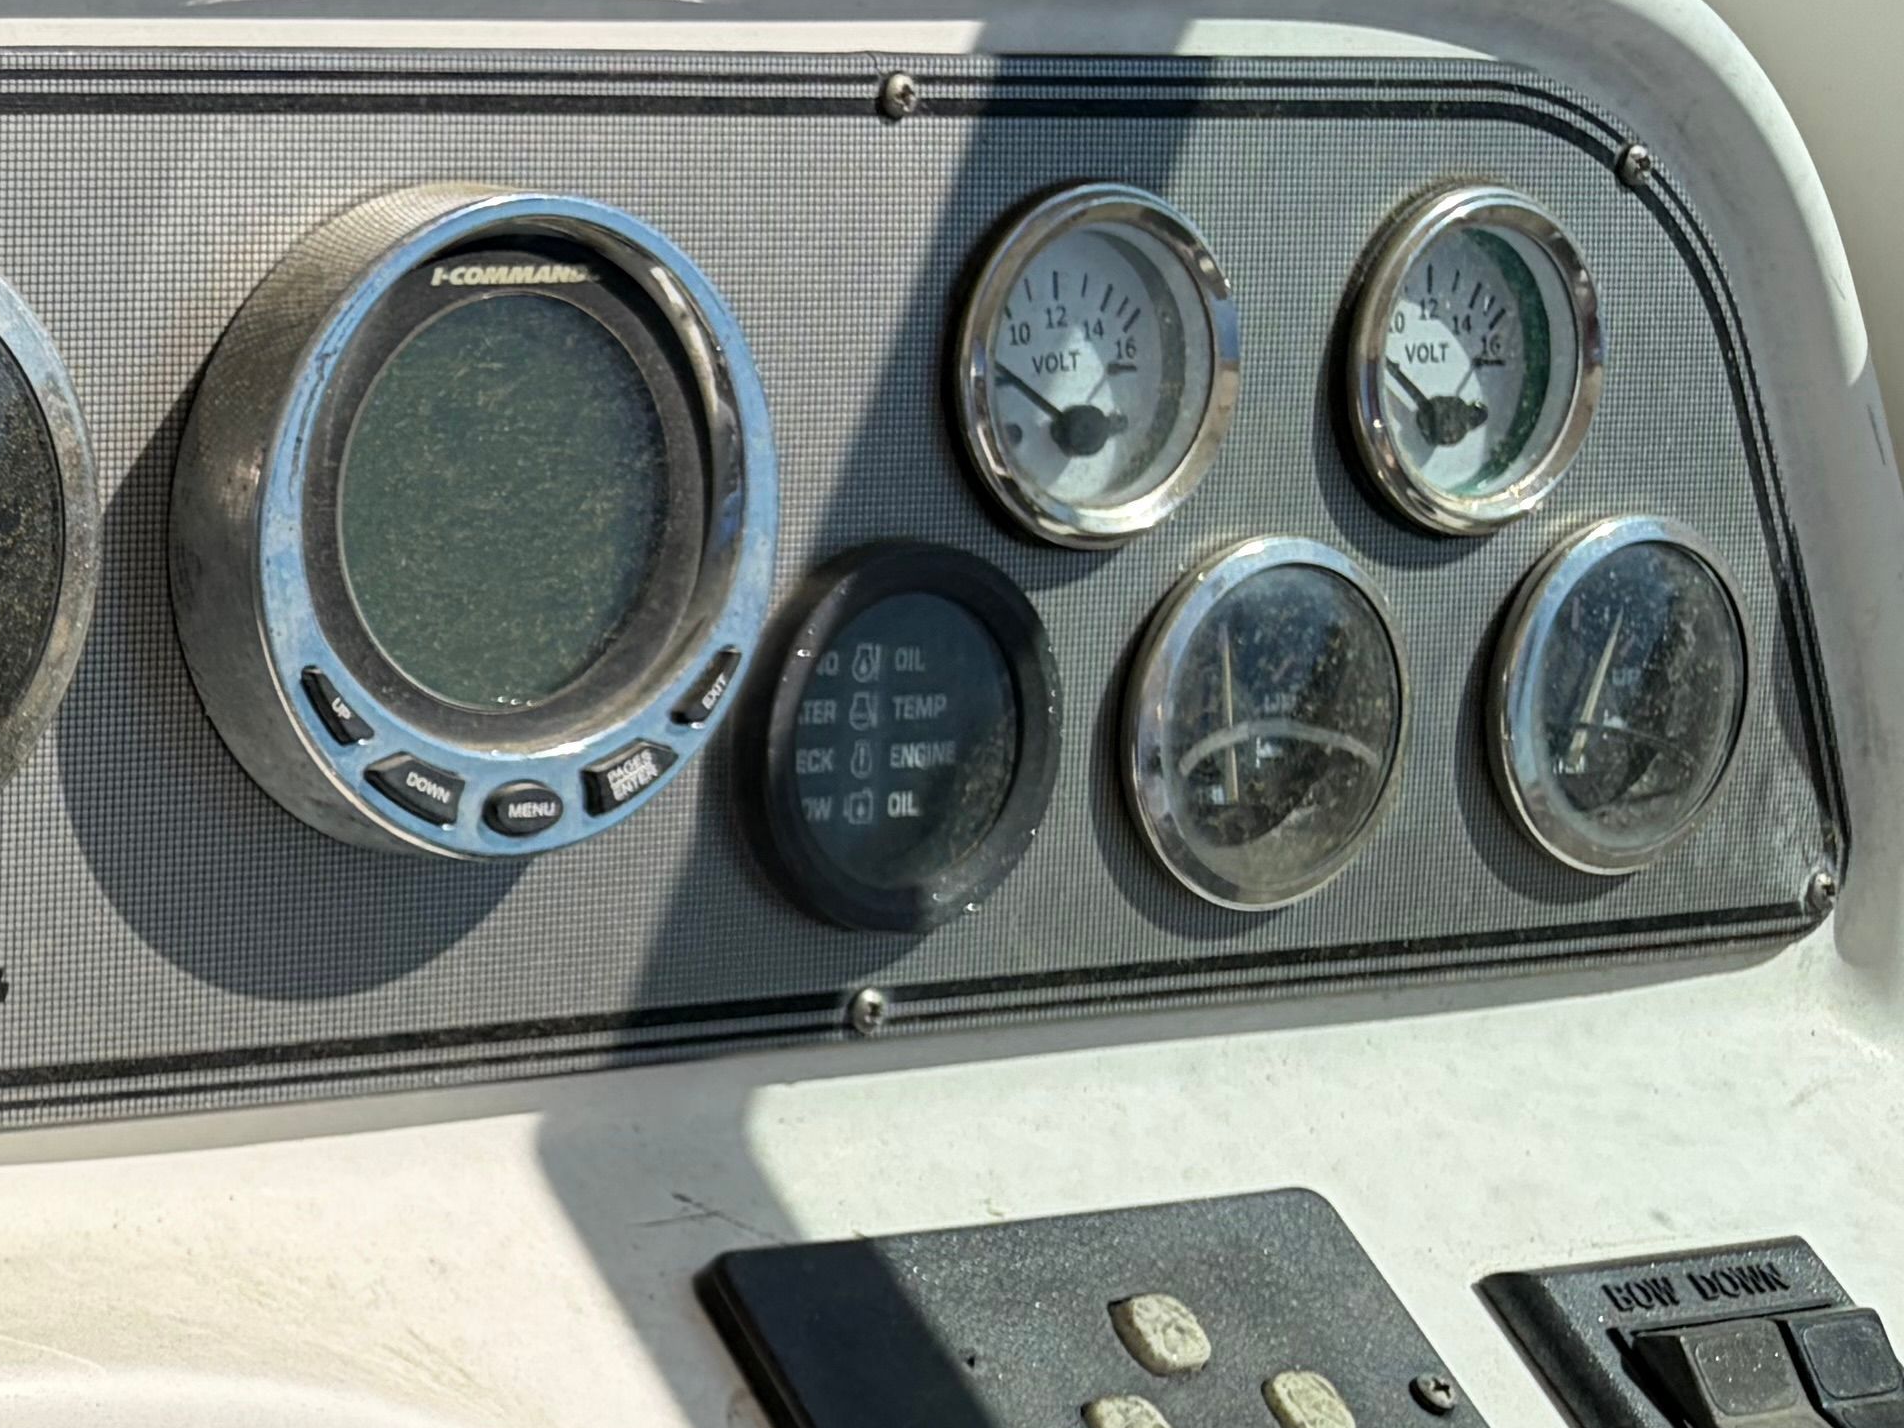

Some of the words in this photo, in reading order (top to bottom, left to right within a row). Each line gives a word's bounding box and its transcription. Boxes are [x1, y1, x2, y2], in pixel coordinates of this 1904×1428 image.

[1044, 307, 1067, 329] 12
[1420, 298, 1439, 320] 12
[1083, 319, 1103, 341] 14
[1389, 312, 1405, 333] 0
[1453, 315, 1471, 335] 14
[1009, 323, 1030, 346] 10
[1114, 338, 1136, 359] 16
[1405, 343, 1448, 363] VOLT
[1031, 352, 1081, 374] VOLT
[895, 647, 925, 672] OIL
[701, 674, 727, 710] EXIT
[331, 697, 352, 721] UP
[892, 694, 947, 720] TEMP
[890, 741, 956, 770] ENGINE
[406, 771, 450, 803] DOWN
[509, 802, 555, 818] MENU
[887, 790, 920, 818] OIL
[1602, 1277, 1680, 1312] BOW
[1687, 1263, 1790, 1301] DOWN
